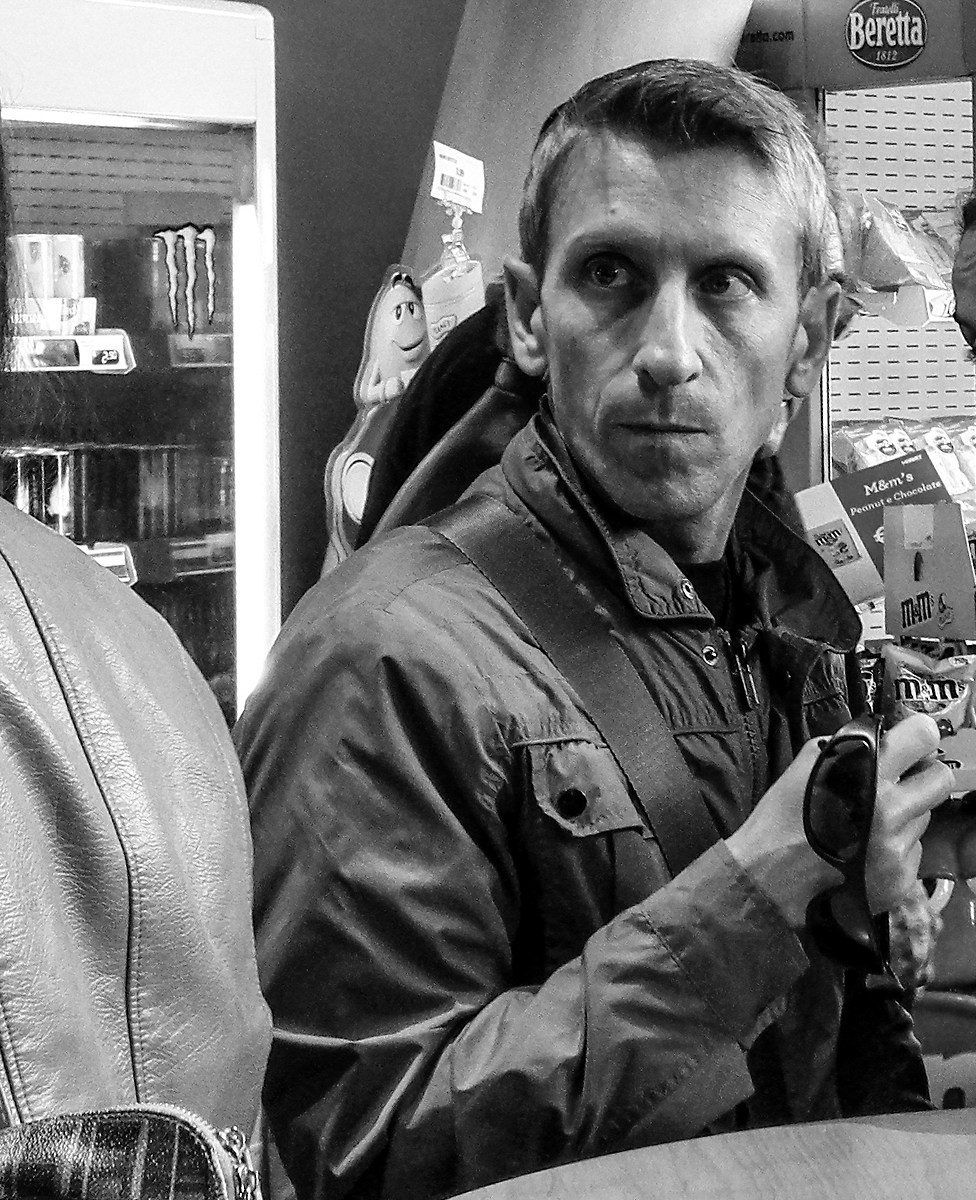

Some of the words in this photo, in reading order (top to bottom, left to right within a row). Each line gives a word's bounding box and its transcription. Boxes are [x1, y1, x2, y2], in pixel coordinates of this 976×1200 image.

[849, 11, 924, 50] Beretta
[876, 50, 898, 62] 1812
[850, 499, 885, 516] Peanut
[893, 480, 942, 500] Chocolate
[863, 472, 914, 496] M&m's
